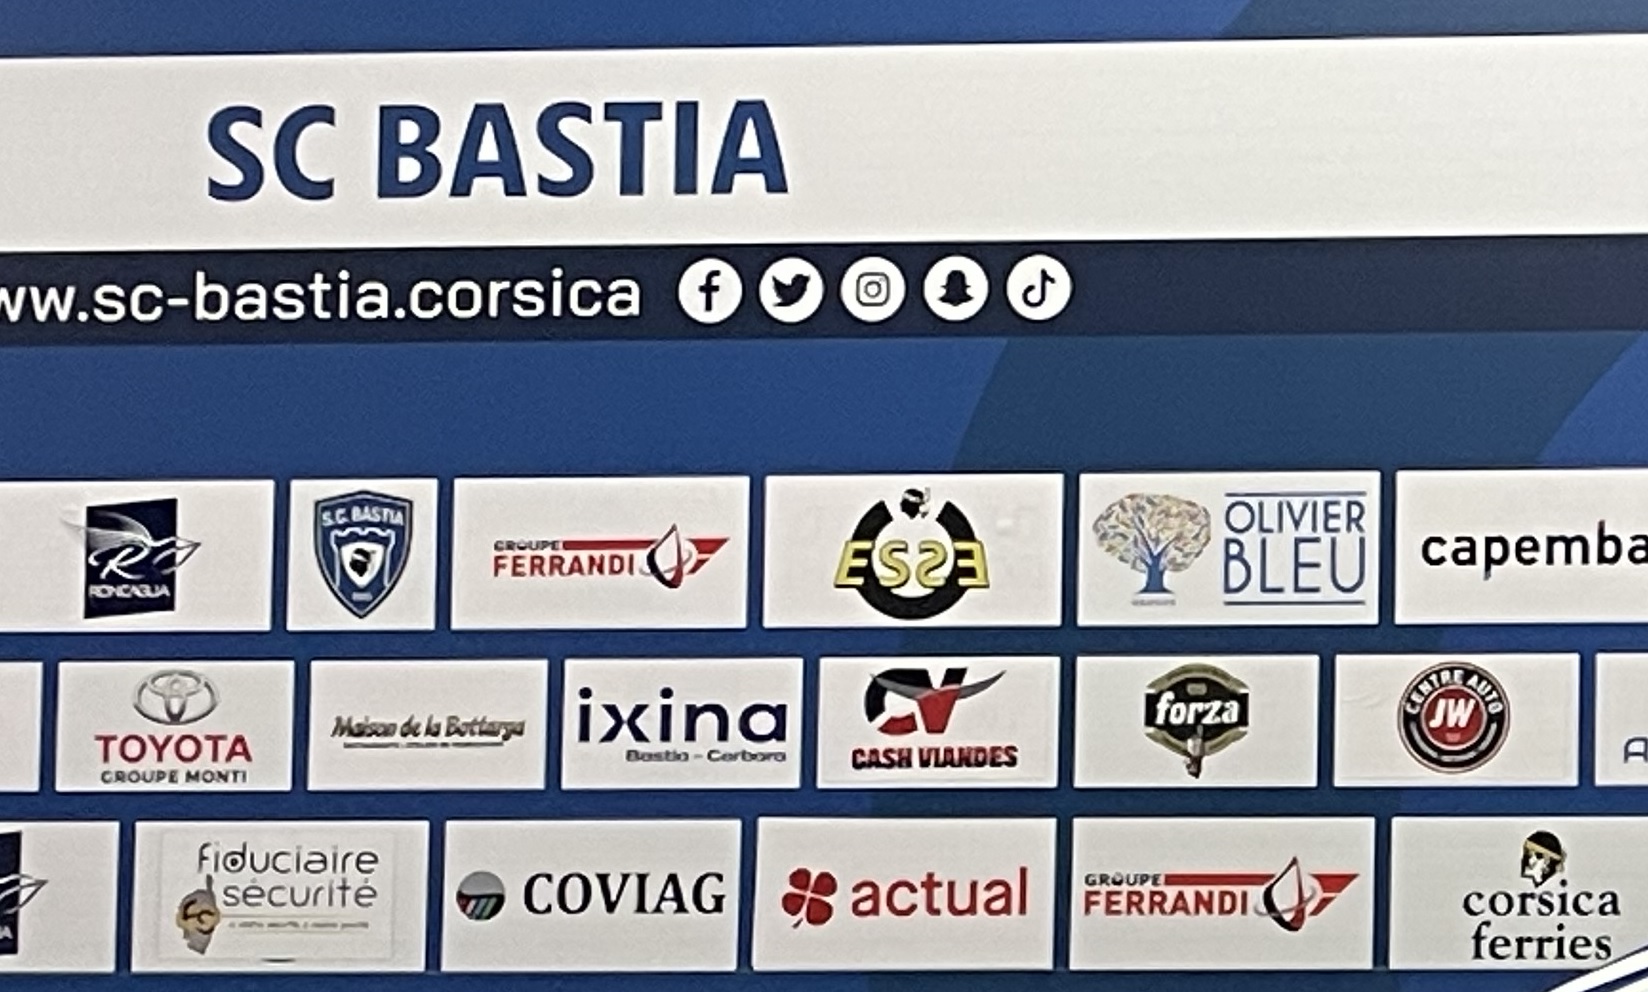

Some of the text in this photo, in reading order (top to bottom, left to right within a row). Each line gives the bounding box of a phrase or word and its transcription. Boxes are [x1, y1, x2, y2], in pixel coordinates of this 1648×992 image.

[207, 98, 789, 203] SC BASTIA
[352, 505, 405, 528] BASTIA
[1225, 499, 1365, 534] OLIVIER
[494, 540, 560, 551] GROUPE
[494, 554, 634, 577] FERRANDI
[1223, 536, 1366, 594] BLEU
[1405, 670, 1503, 714] CENTRE AUTO
[577, 687, 787, 743] ixina
[1153, 696, 1239, 726] forza
[1429, 699, 1476, 728] JW
[95, 734, 253, 763] TOYOTA
[852, 746, 1018, 770] CASH VIANDES
[101, 769, 247, 784] GROUPE MONTI
[197, 843, 378, 875] fiduciaire
[523, 871, 725, 915] COVIAG
[851, 867, 1028, 916] actual
[1085, 873, 1162, 887] GROUPE
[1084, 890, 1248, 915] FERRANDI
[1463, 879, 1621, 916] corsica
[1471, 921, 1611, 961] ferries
